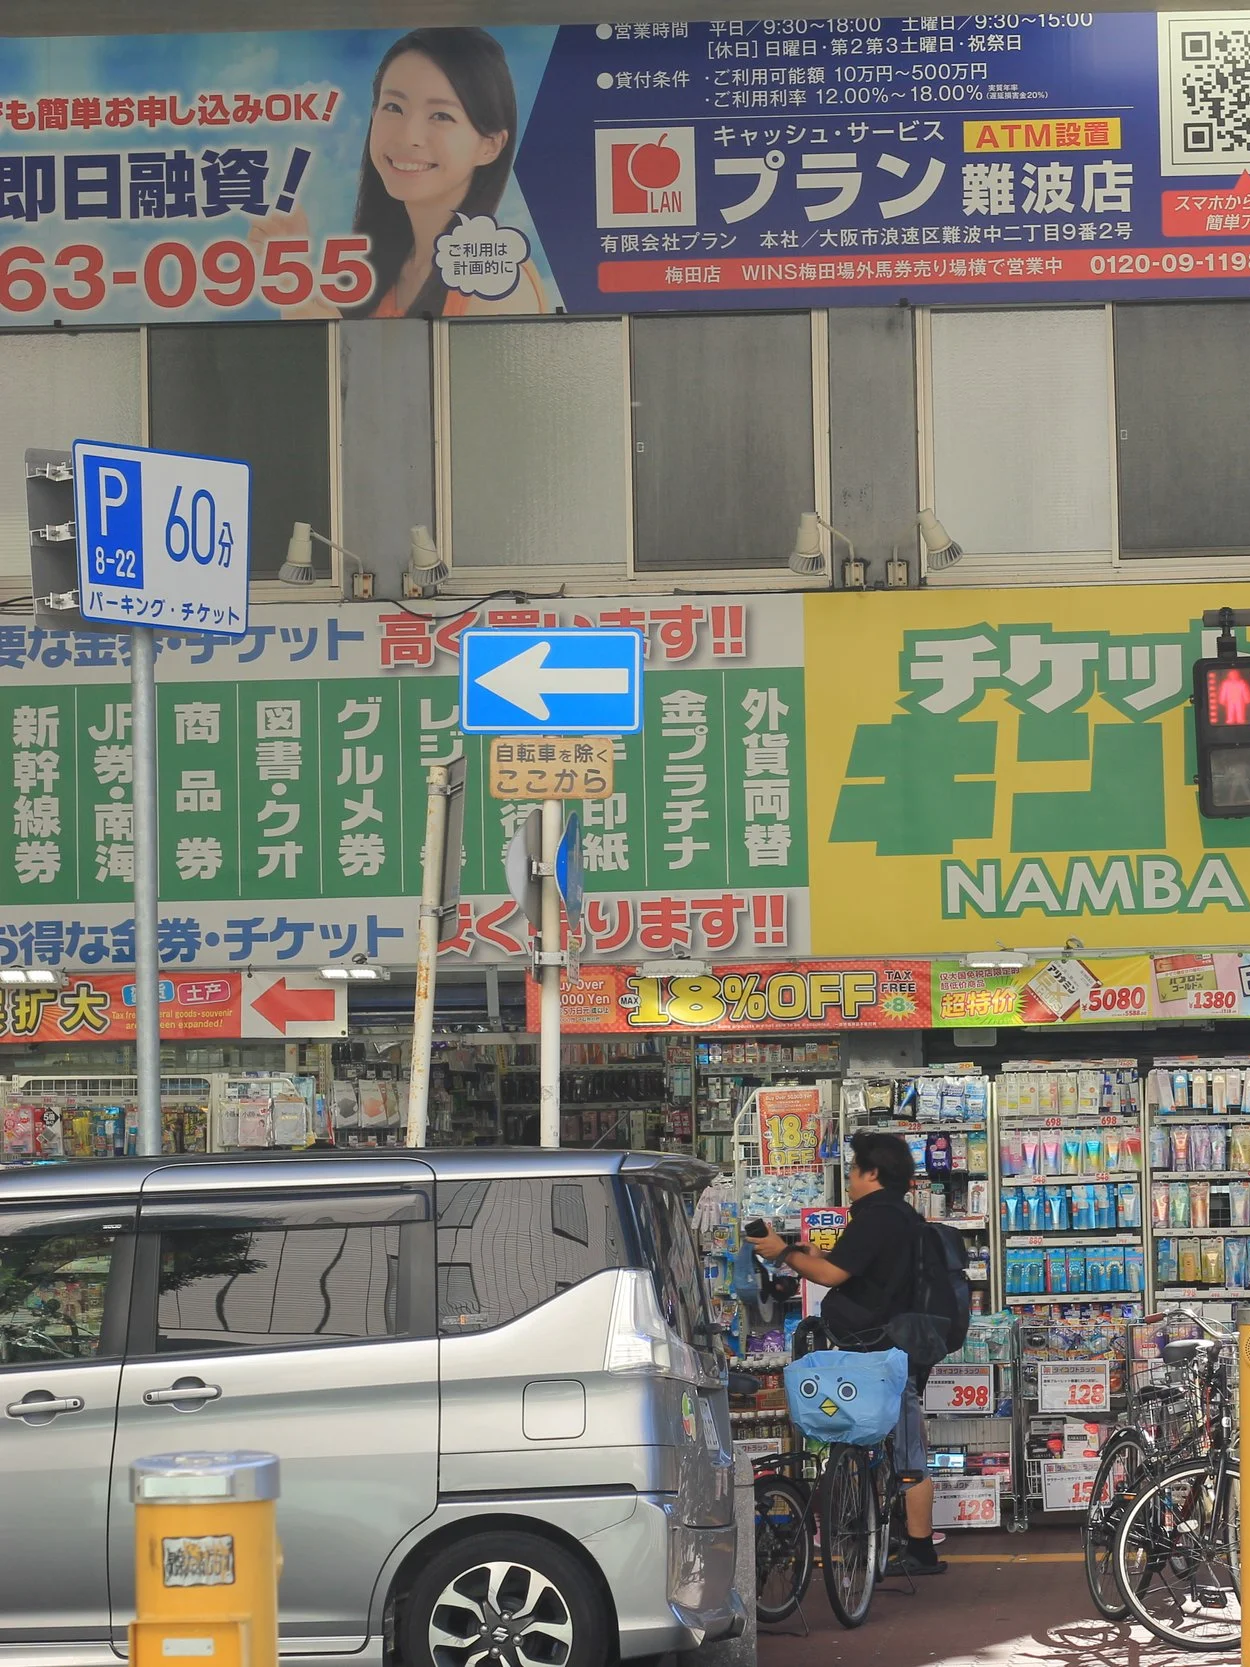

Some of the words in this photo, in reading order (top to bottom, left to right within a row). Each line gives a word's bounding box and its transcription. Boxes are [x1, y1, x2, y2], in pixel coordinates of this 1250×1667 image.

[614, 22, 688, 39] 営業時間
[616, 72, 690, 89] 貸付条件
[0, 91, 338, 130] も簡単お申し込みOK!
[714, 120, 945, 147] キャッシュ・サービス
[976, 122, 1109, 148] ATM設置
[0, 147, 311, 222] 即日融資!
[714, 149, 946, 224] プラン
[961, 160, 1134, 216] 難波店
[449, 243, 508, 258] ご利用は
[601, 232, 736, 253] 有限会社プラン
[0, 239, 374, 312] 63-0955
[454, 260, 514, 276] 計画的に
[665, 266, 721, 284] 梅田店
[742, 257, 1062, 281] WINS梅田場外馬券売り場横で営業中
[98, 466, 128, 536] P
[165, 485, 234, 568] 60分
[95, 546, 136, 579] 8-22
[90, 590, 240, 626] パーキング・チケット
[379, 604, 746, 668] 高くす!!
[495, 744, 608, 764] 自転車を除く
[174, 702, 223, 881] 商品券
[256, 700, 302, 879] 図書・クオ
[336, 697, 387, 877] グルメ券
[498, 769, 606, 793] ここから
[661, 690, 710, 869] 金プラチナ
[741, 688, 792, 867] 外貨両替
[12, 704, 62, 884] 新幹線券
[944, 857, 1250, 916] NAMBA
[560, 983, 572, 992] uy
[576, 980, 604, 990] Over
[881, 982, 916, 993] FREE
[885, 970, 912, 981] TAX
[1047, 964, 1076, 995] アリナミン
[1169, 973, 1204, 985] パブロン
[186, 983, 222, 1001] 土产
[587, 994, 610, 1004] Yen
[621, 997, 639, 1005] MAX
[628, 972, 877, 1025] 18%OFF
[941, 988, 1016, 1019] 超特价
[0, 984, 109, 1034] 扩大
[112, 1011, 124, 1020] Tax
[178, 1020, 223, 1030] expanded!
[766, 1113, 818, 1149] 18%
[806, 1213, 846, 1226] 本日の
[808, 1228, 845, 1252] 特
